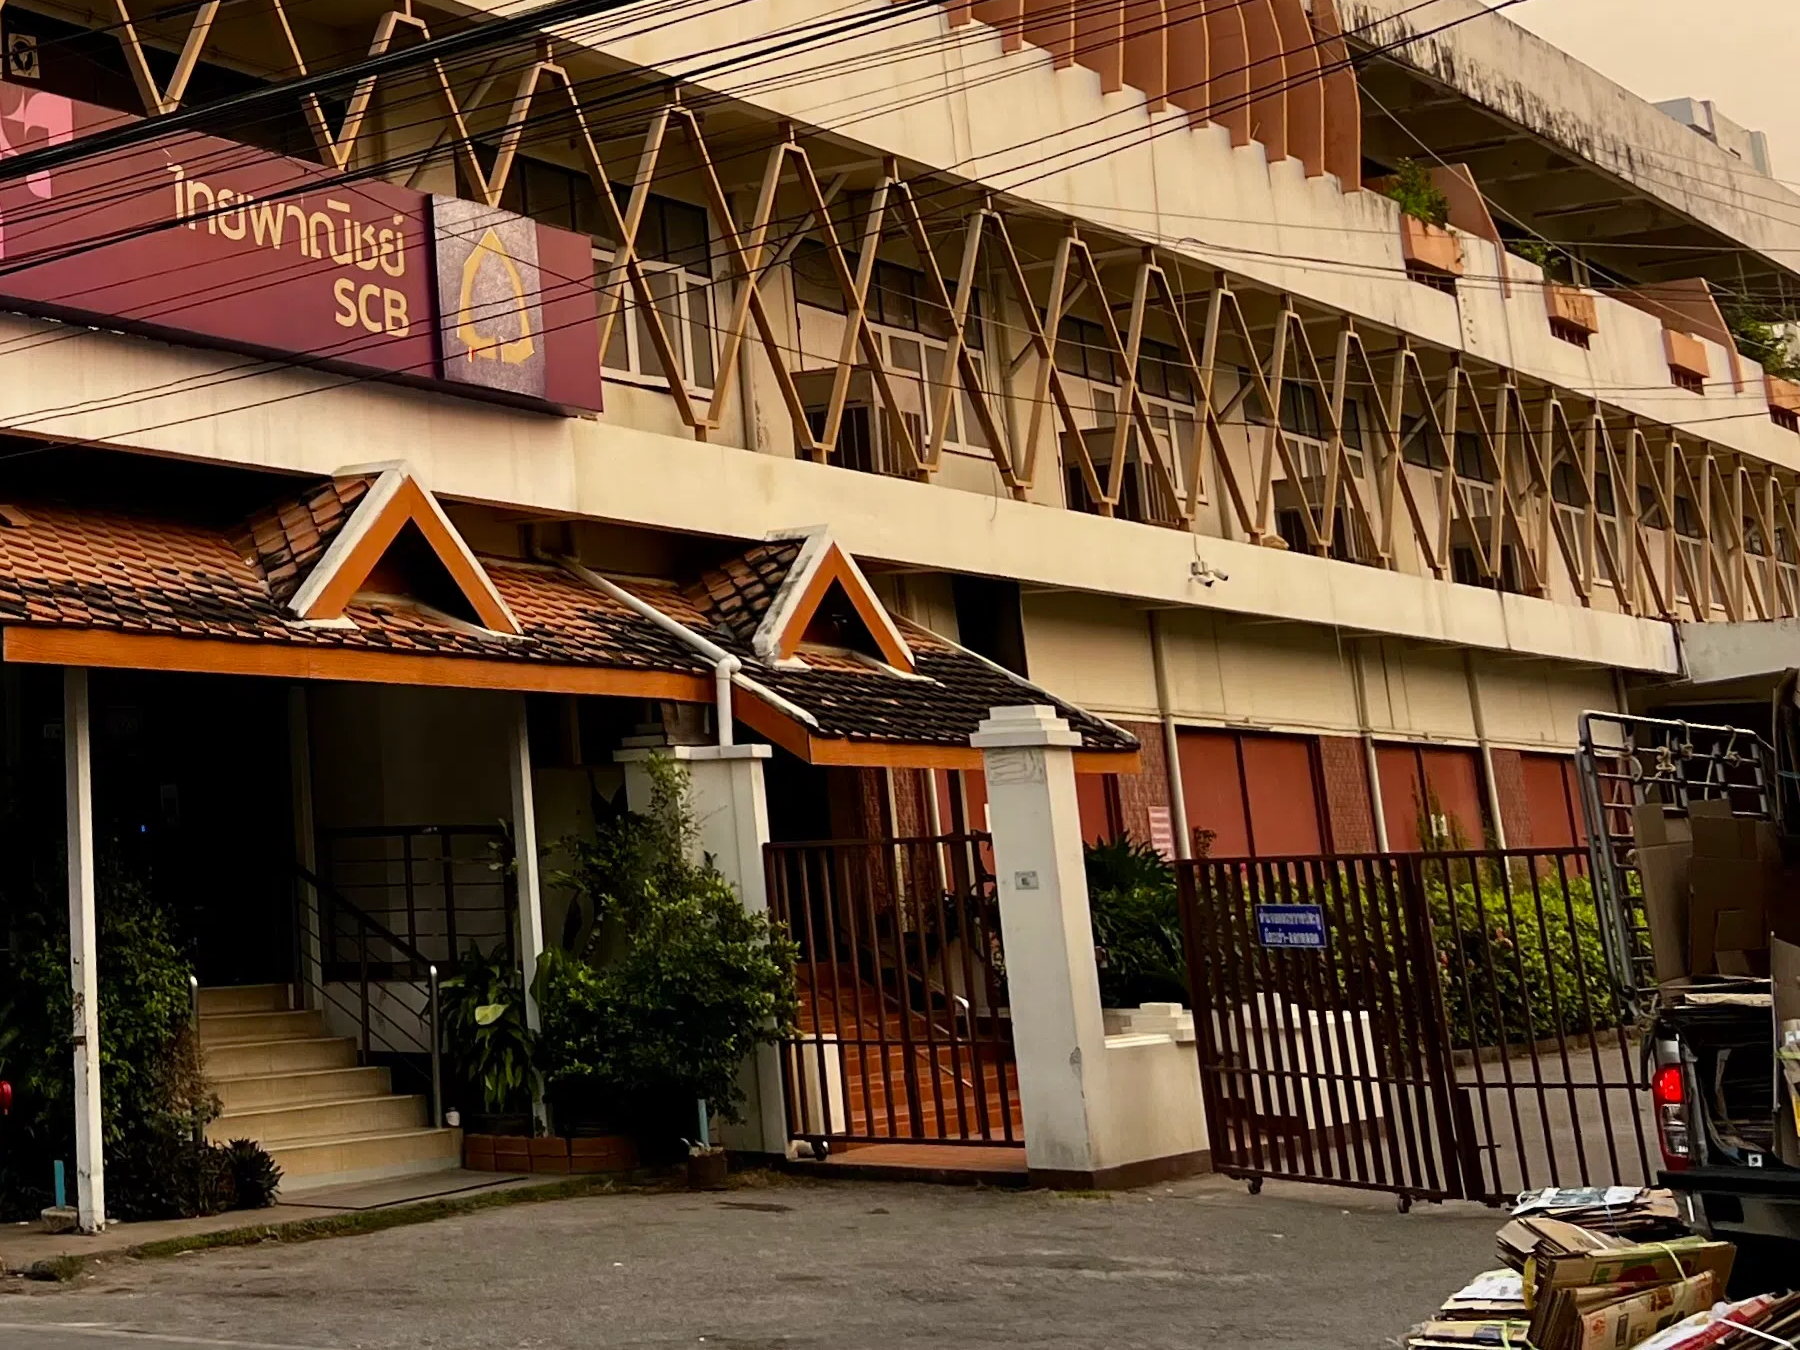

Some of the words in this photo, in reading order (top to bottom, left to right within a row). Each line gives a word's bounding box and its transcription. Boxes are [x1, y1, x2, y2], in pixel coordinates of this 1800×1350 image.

[166, 162, 406, 278] ไทยพาณิชย์
[333, 277, 410, 338] SCB
